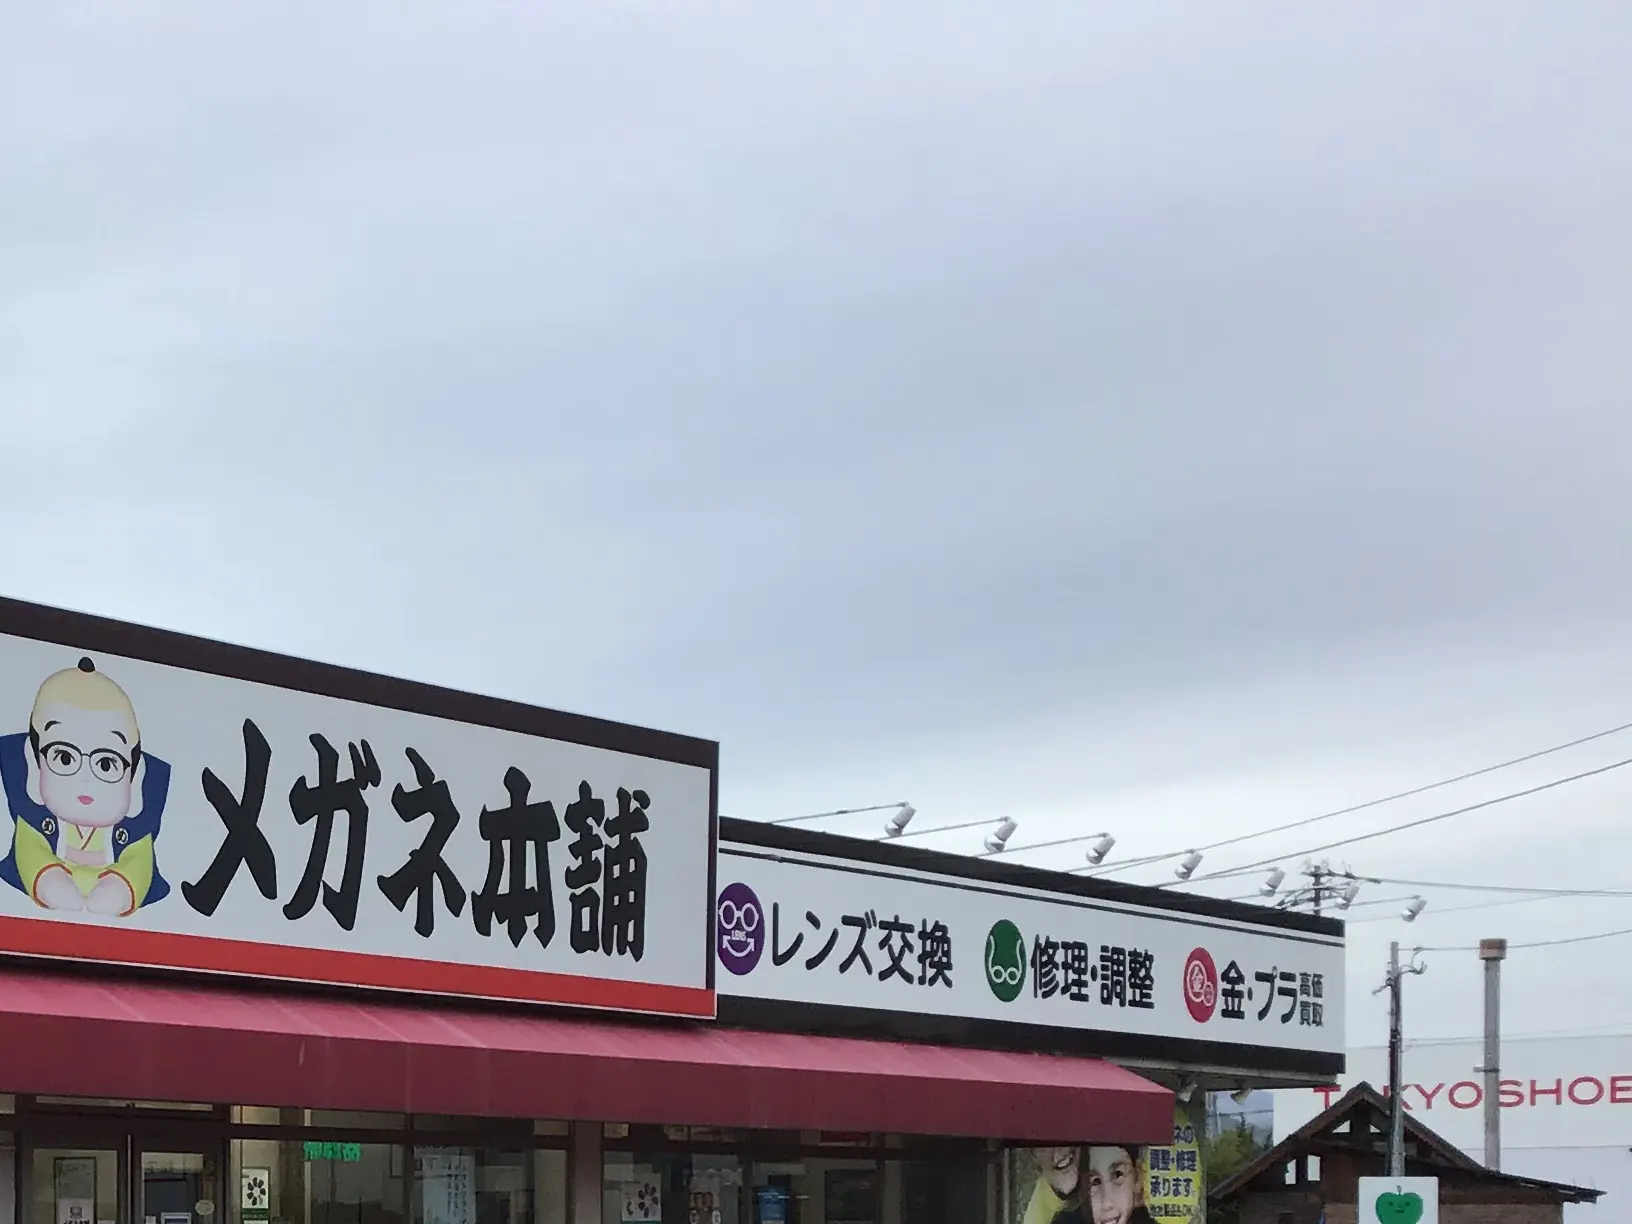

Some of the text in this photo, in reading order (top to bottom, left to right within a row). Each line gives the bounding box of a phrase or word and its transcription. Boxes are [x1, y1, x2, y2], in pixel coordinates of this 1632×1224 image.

[180, 718, 650, 962] メガネ本舗
[772, 901, 954, 990] レンズ交換
[1030, 934, 1156, 1010] 修理・調整
[1220, 960, 1298, 1024] 金・プラ
[1313, 1081, 1483, 1111] TKYO
